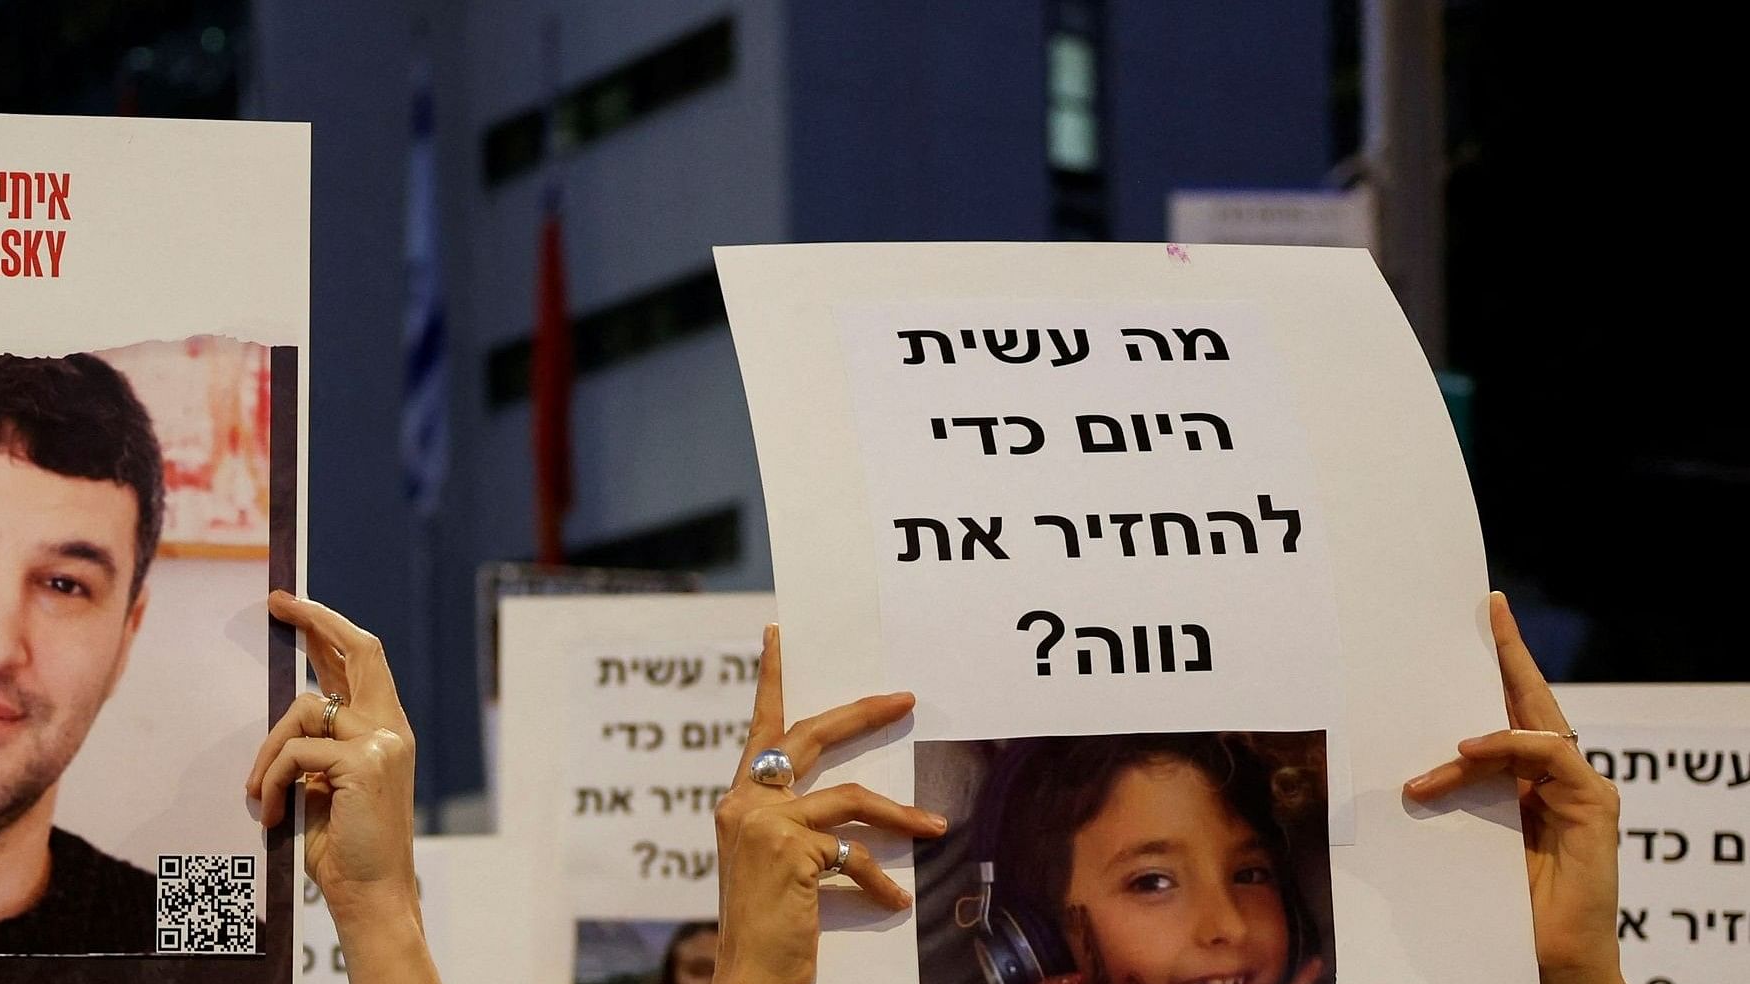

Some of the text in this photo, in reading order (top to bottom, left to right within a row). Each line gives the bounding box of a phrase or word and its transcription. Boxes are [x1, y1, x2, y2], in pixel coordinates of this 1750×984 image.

[896, 327, 1230, 368] מה עשית
[930, 412, 1234, 456] היום כדי
[893, 494, 1302, 562] להחזיר את
[1016, 610, 1213, 677] נווה?
[597, 654, 763, 688] ה עשית
[602, 722, 664, 750] כדי
[576, 787, 634, 814] את
[1618, 830, 1690, 863] כד
[1618, 907, 1750, 942] זיר א
